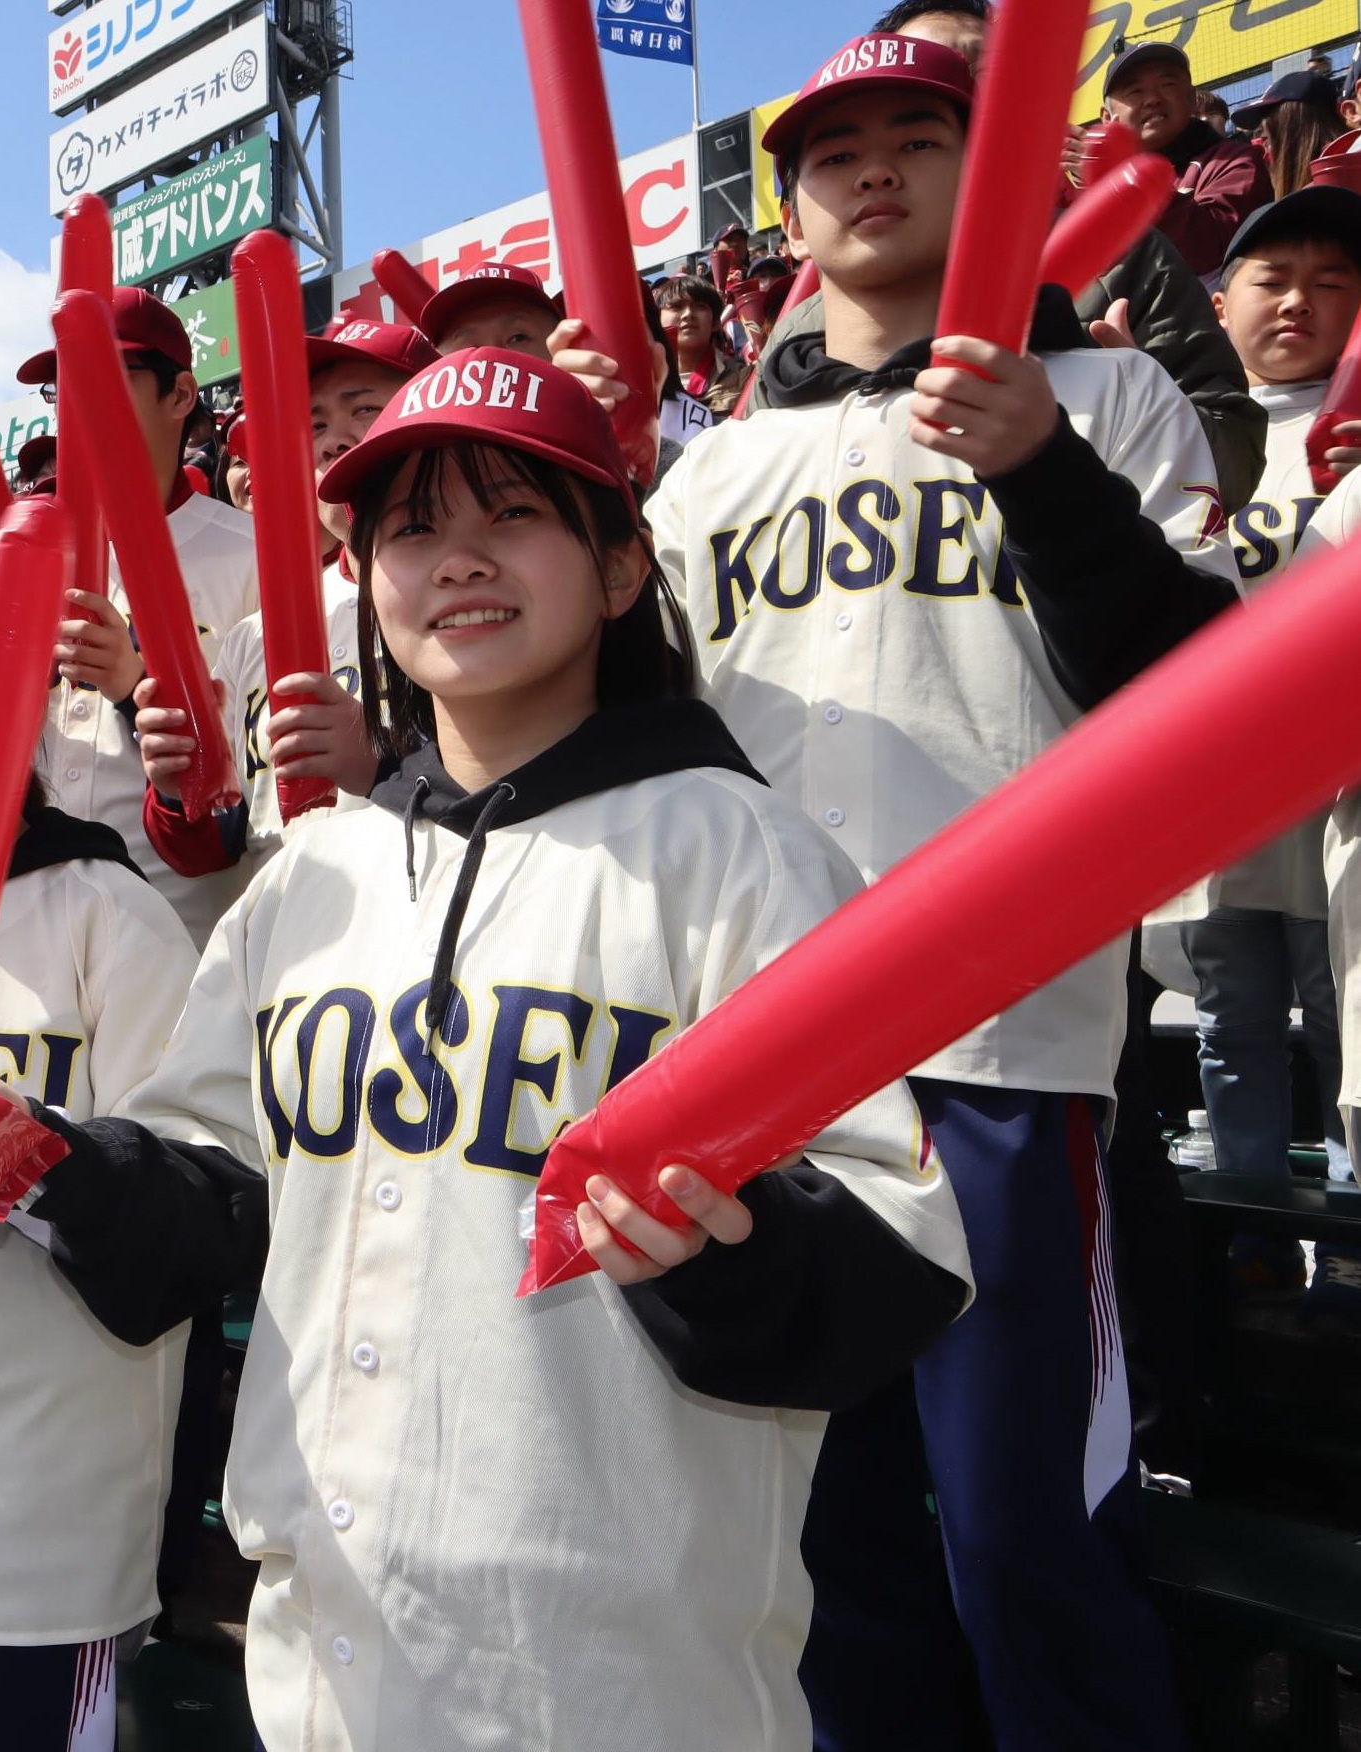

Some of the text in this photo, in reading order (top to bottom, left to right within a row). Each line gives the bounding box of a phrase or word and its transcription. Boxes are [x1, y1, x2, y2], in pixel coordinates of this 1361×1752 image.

[53, 75, 84, 100] Shinobu
[816, 39, 916, 89] KOSEI
[97, 67, 229, 158] ウメダチーズラボ
[112, 162, 266, 286] 成アドバンス
[333, 323, 381, 343] SEI
[398, 359, 544, 419] KOSEI
